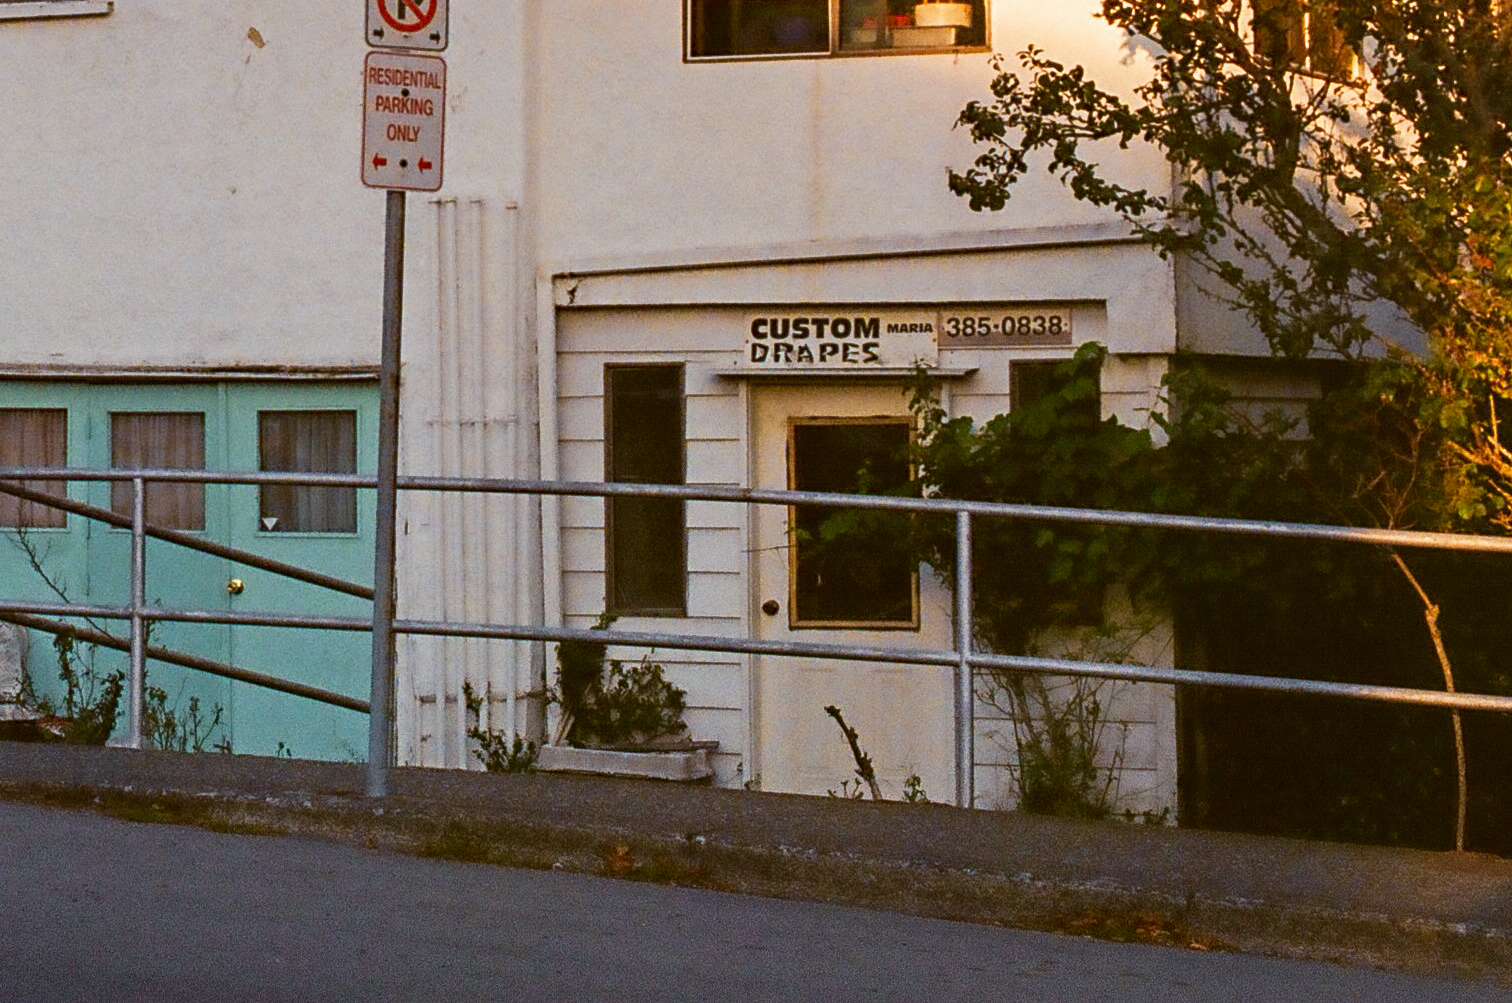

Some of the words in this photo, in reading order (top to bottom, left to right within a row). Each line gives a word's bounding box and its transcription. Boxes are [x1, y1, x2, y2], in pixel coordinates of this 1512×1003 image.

[368, 67, 441, 89] RESIDENTIAL
[375, 95, 434, 116] PARKING
[386, 123, 421, 142] ONLY
[751, 317, 880, 339] CUSTOM
[887, 323, 933, 334] MARIA
[751, 342, 880, 363] DRAPES
